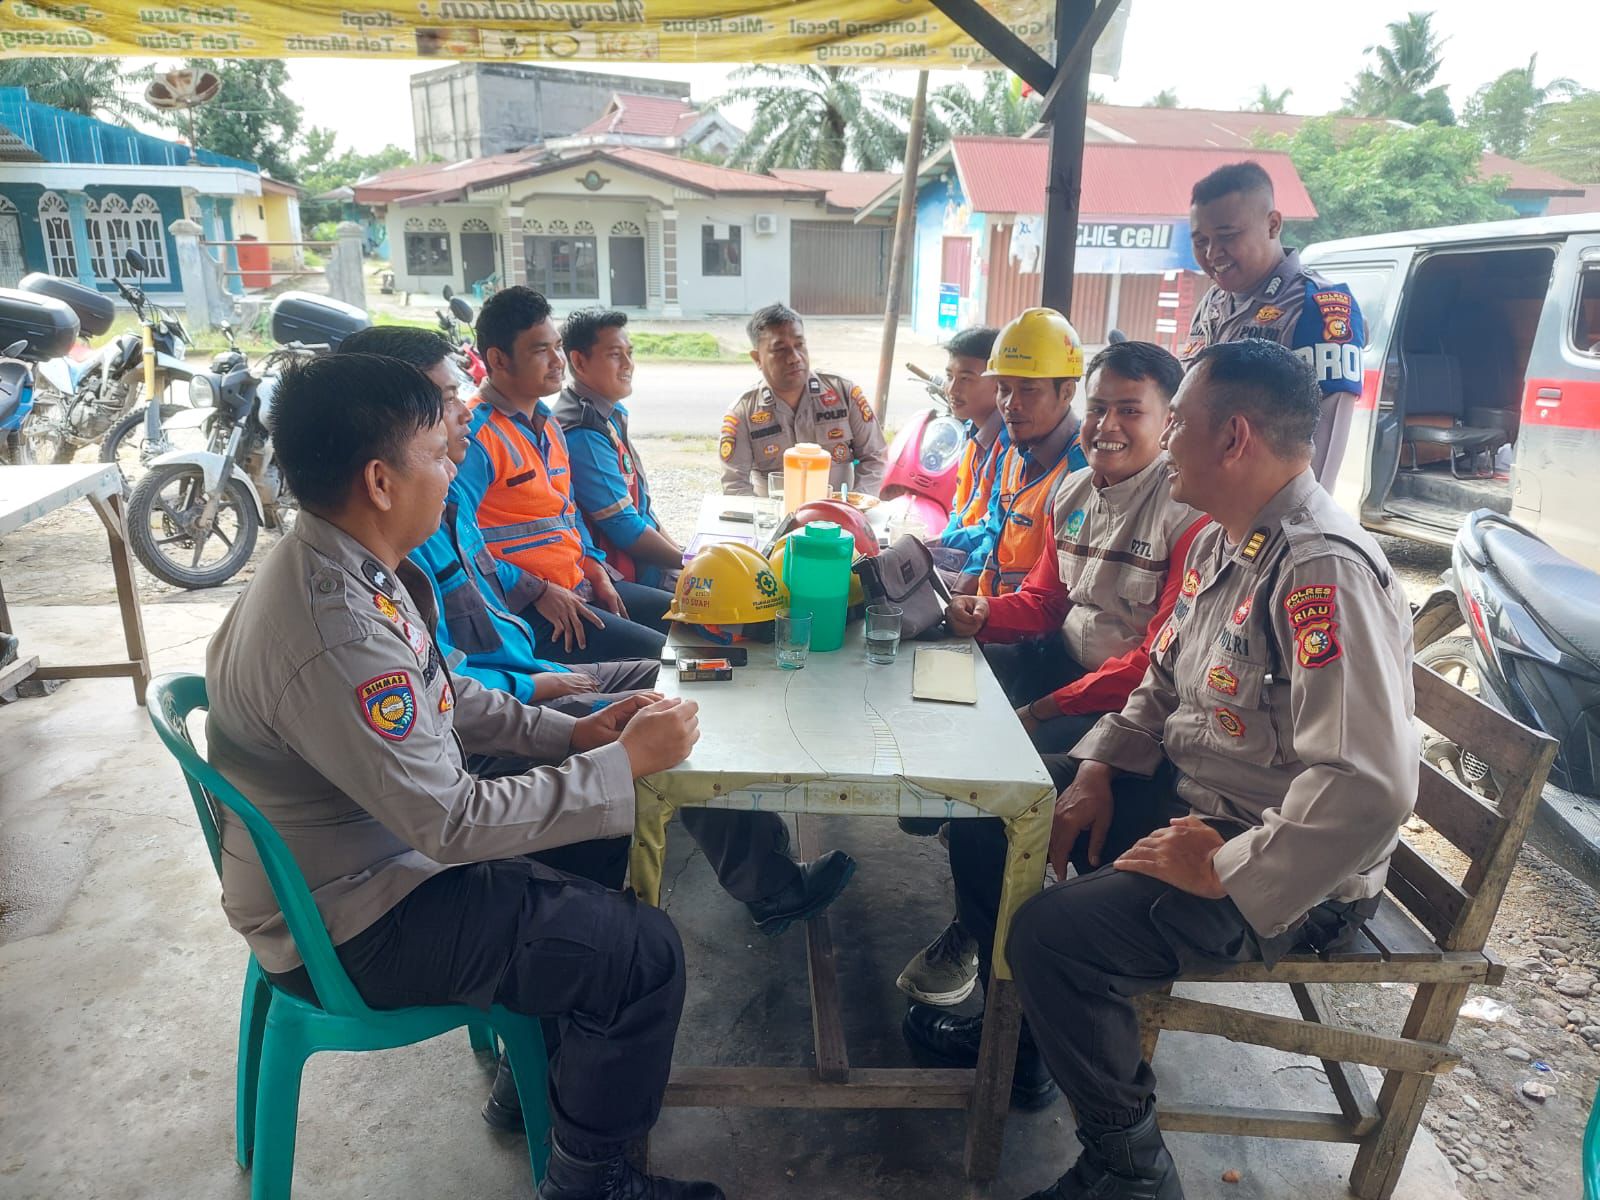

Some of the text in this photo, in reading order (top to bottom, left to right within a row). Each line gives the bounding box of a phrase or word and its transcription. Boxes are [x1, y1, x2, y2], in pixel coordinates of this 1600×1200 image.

[1120, 224, 1170, 248] cell
[815, 409, 848, 421] POLRI
[690, 576, 713, 590] PLN
[1286, 587, 1332, 608] POLRES
[1294, 605, 1329, 623] RIAU
[364, 676, 404, 696] BINMAS
